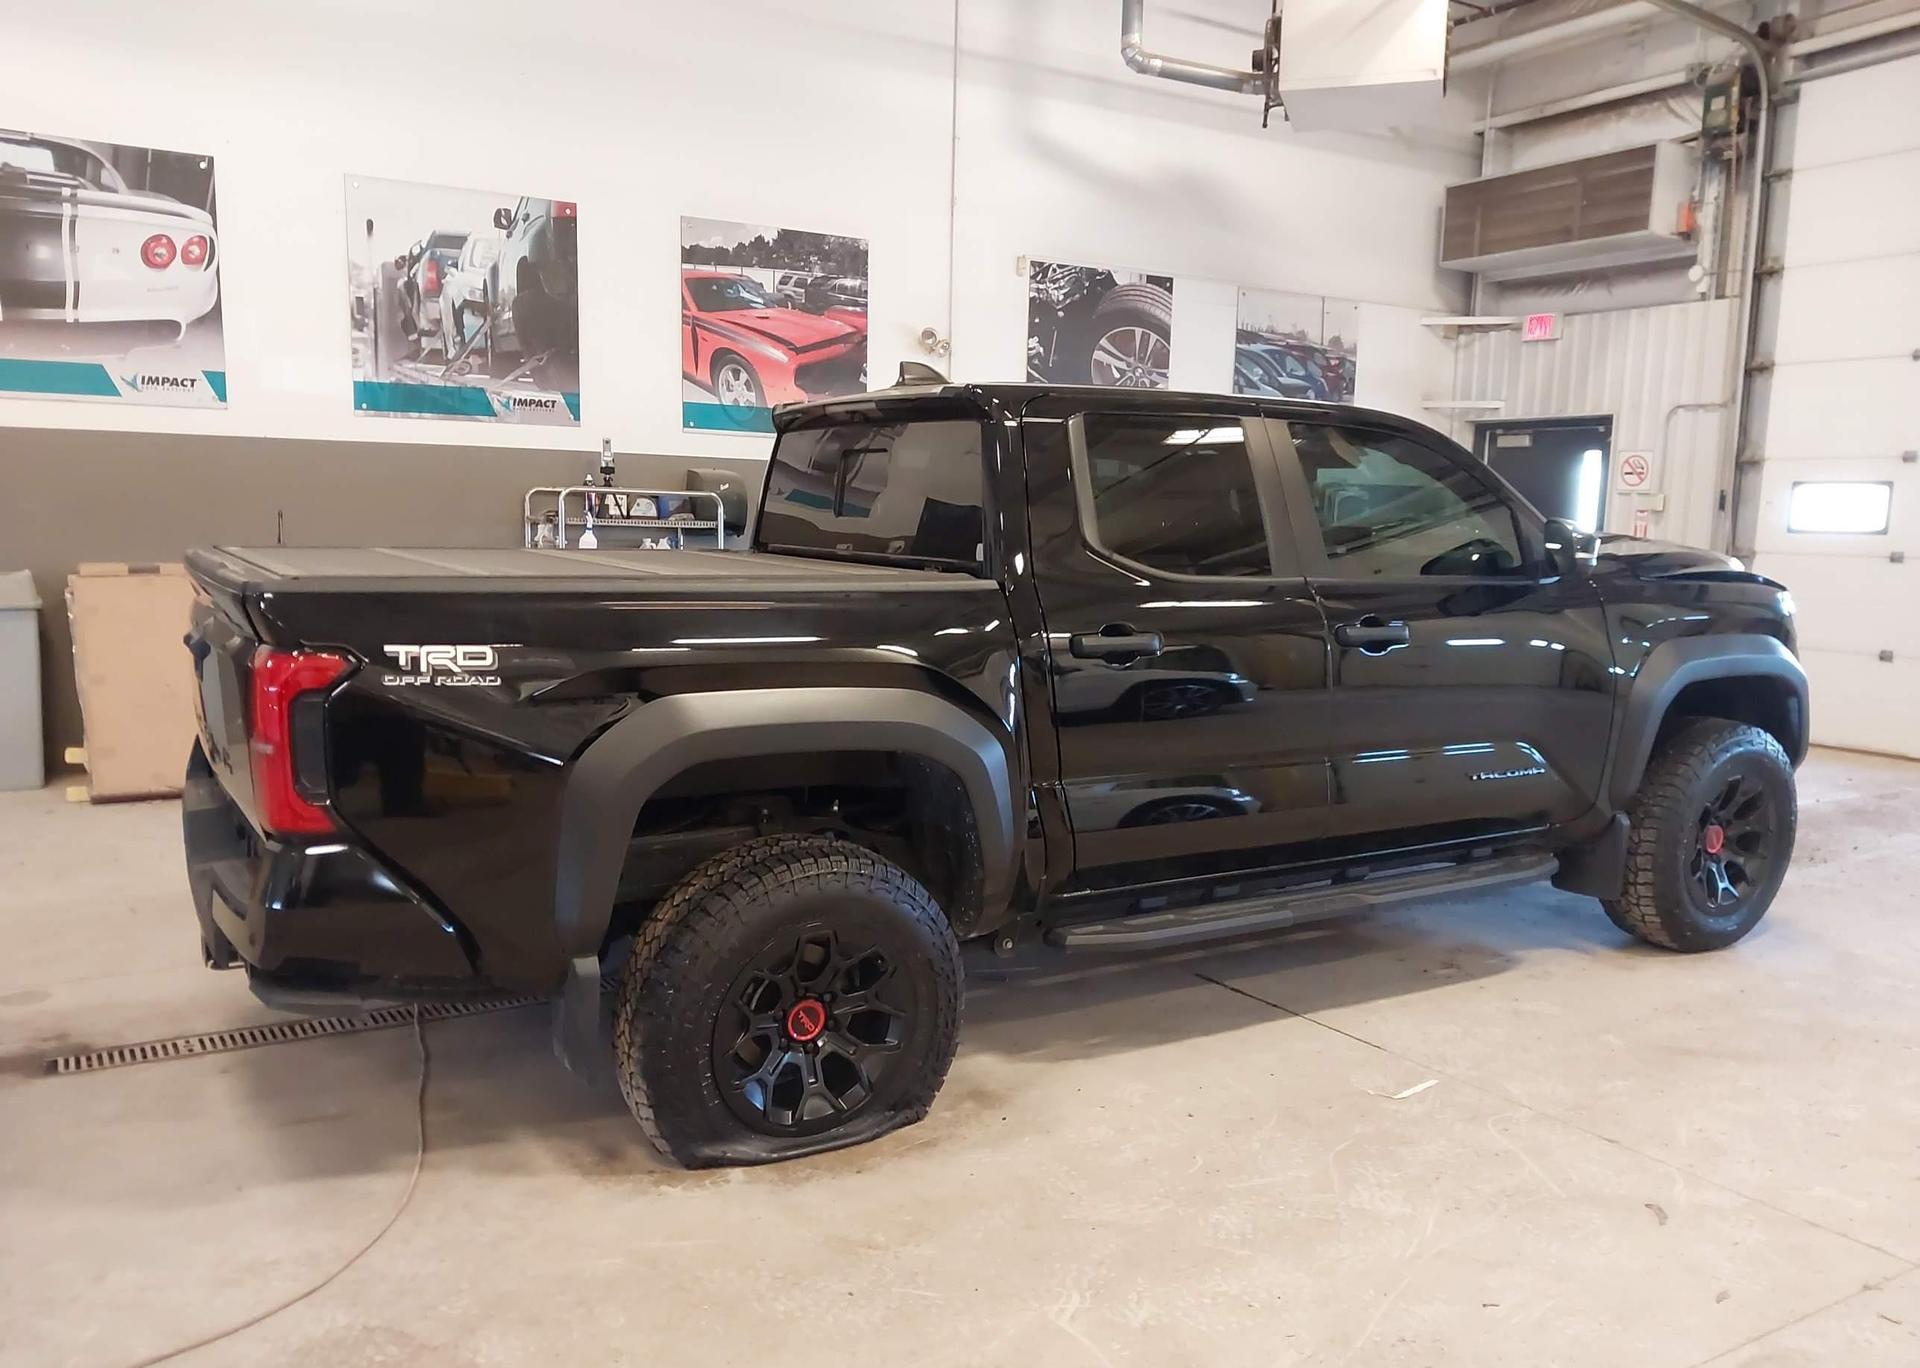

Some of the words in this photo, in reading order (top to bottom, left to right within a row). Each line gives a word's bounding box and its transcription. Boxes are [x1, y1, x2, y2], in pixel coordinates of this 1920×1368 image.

[140, 375, 197, 388] IMPACT
[512, 397, 557, 409] IMPACT
[383, 644, 498, 675] TRD
[382, 674, 431, 686] OFF
[434, 674, 502, 686] ROAD
[798, 1010, 816, 1032] TRD
